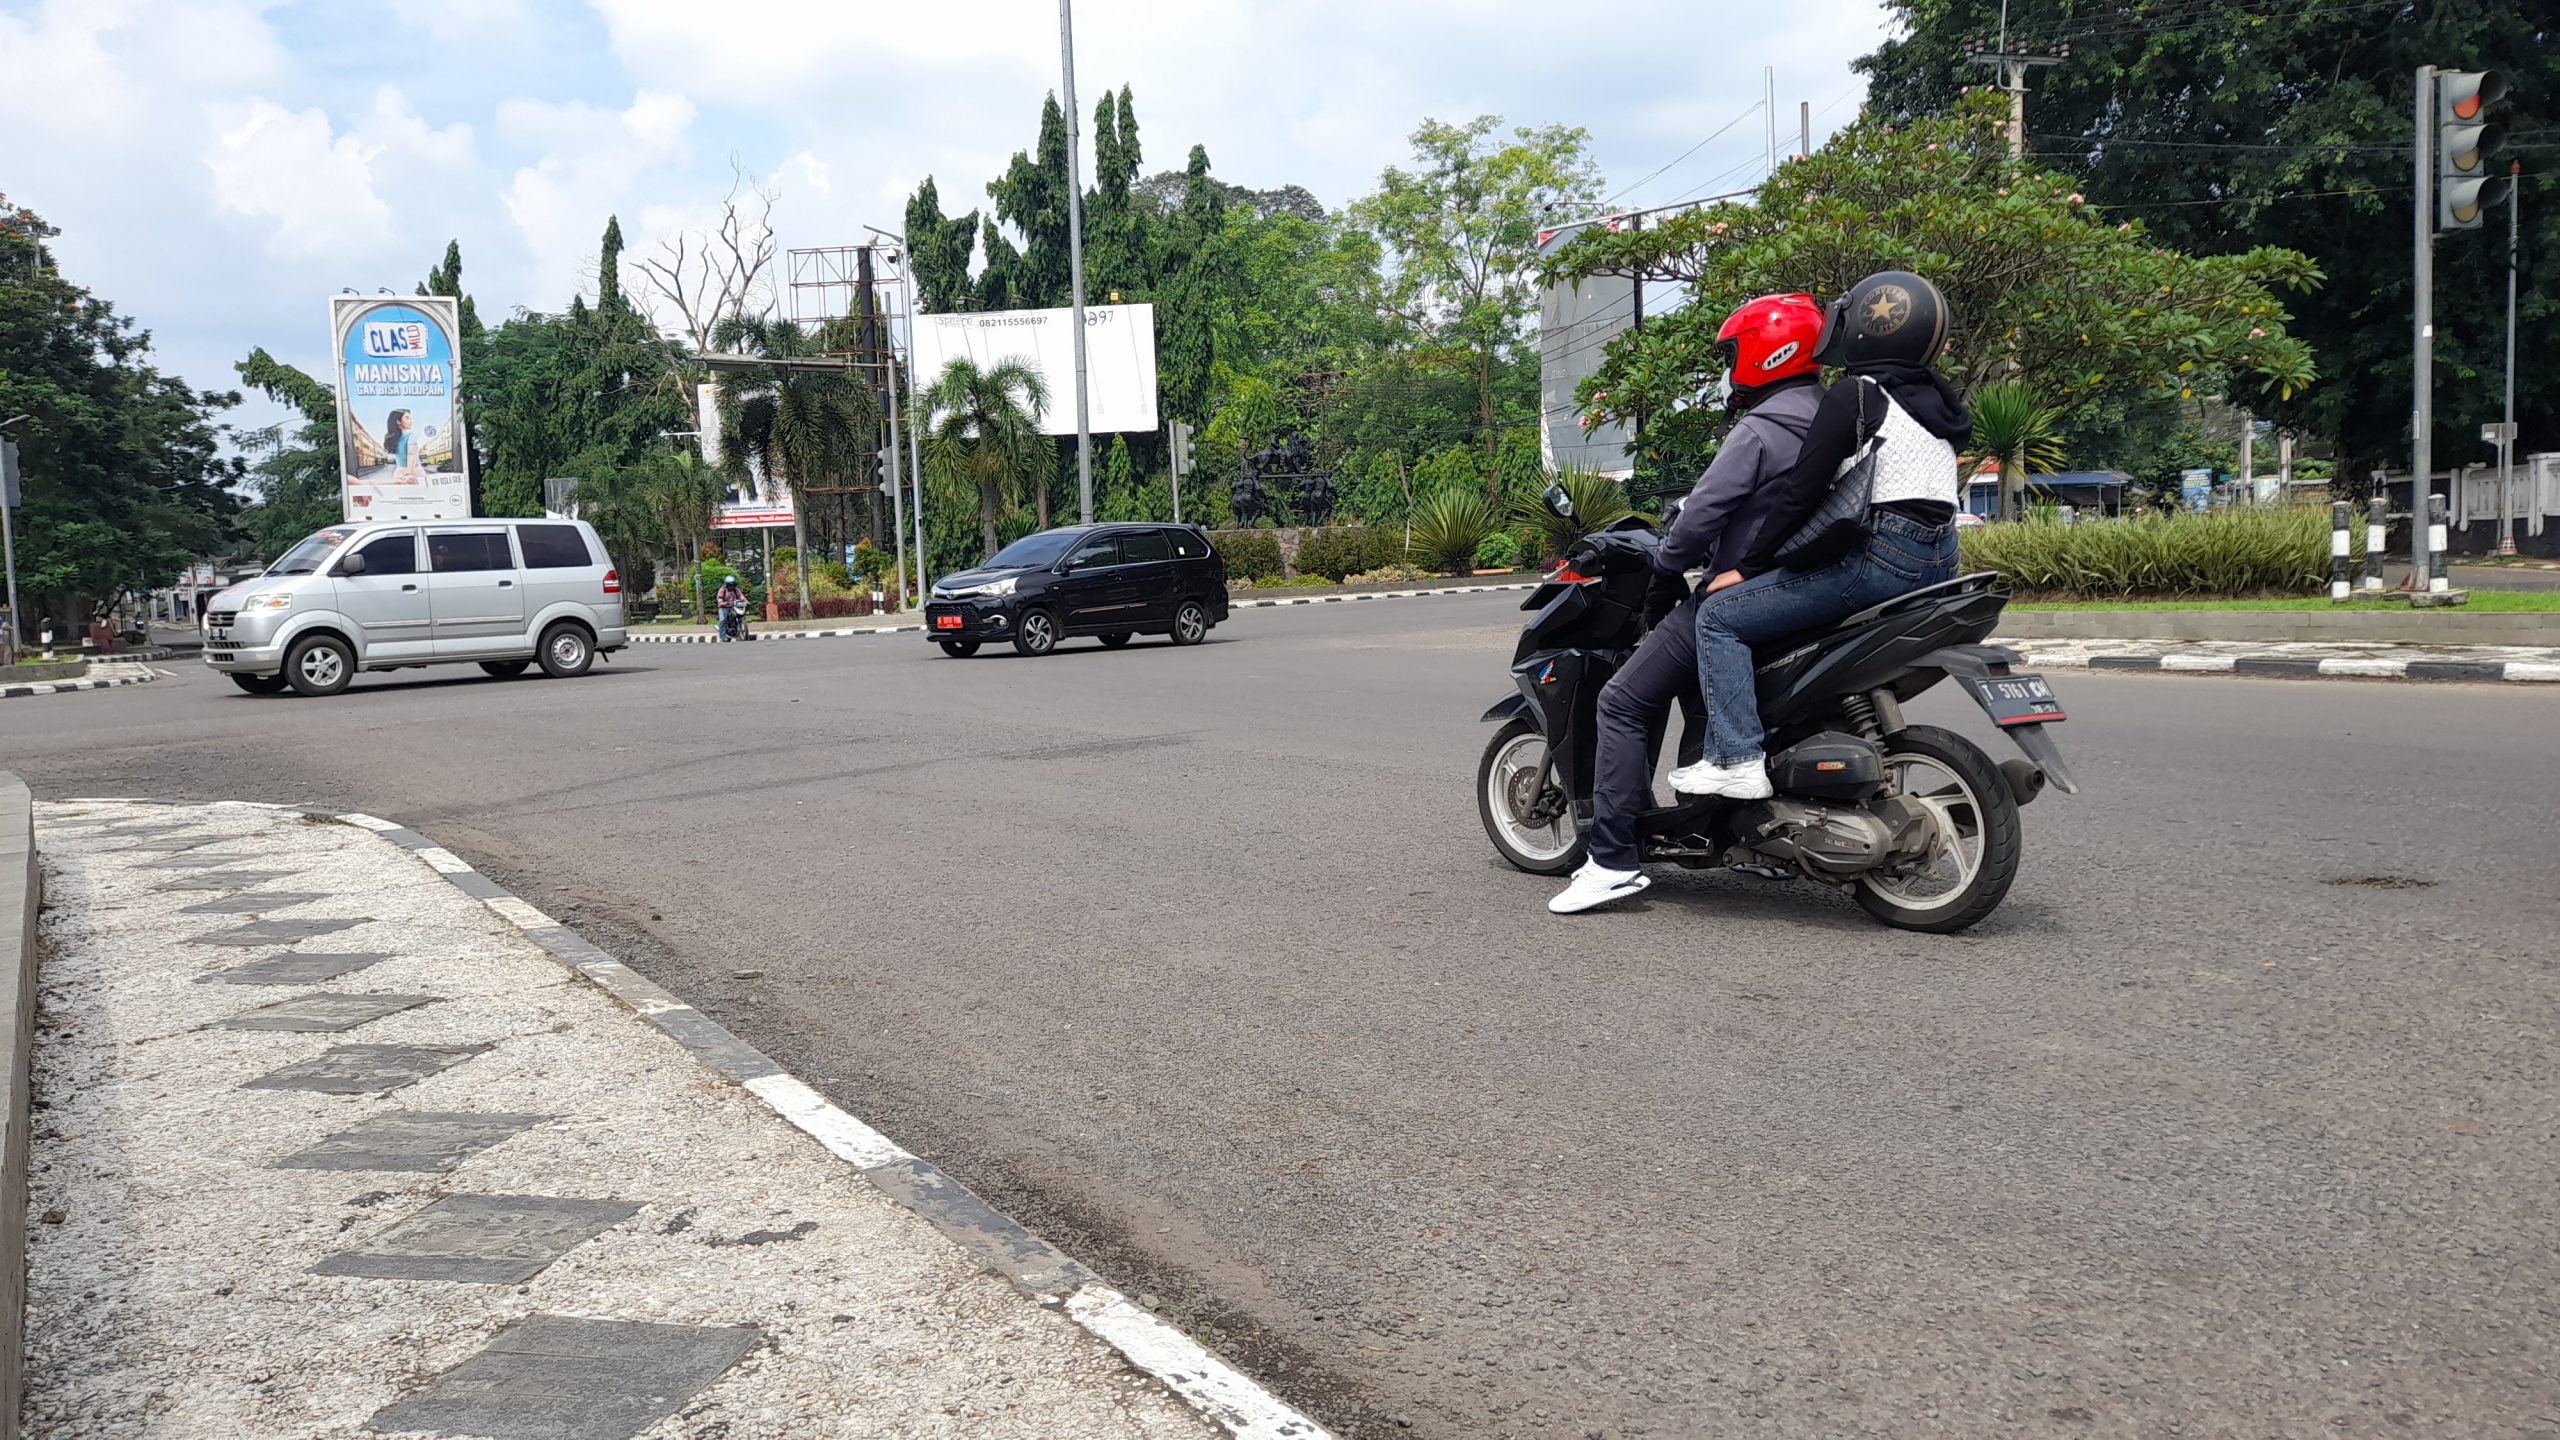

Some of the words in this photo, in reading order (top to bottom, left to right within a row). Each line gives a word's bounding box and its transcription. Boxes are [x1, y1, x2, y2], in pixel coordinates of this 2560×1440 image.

[980, 316, 1048, 327] 082115556697
[370, 327, 408, 353] CLAS
[407, 325, 423, 350] MILD
[1767, 344, 1794, 367] INK
[354, 364, 444, 383] MANISNYA
[378, 384, 401, 396] BISA
[1981, 684, 1994, 701] T
[1997, 683, 2030, 699] 5761
